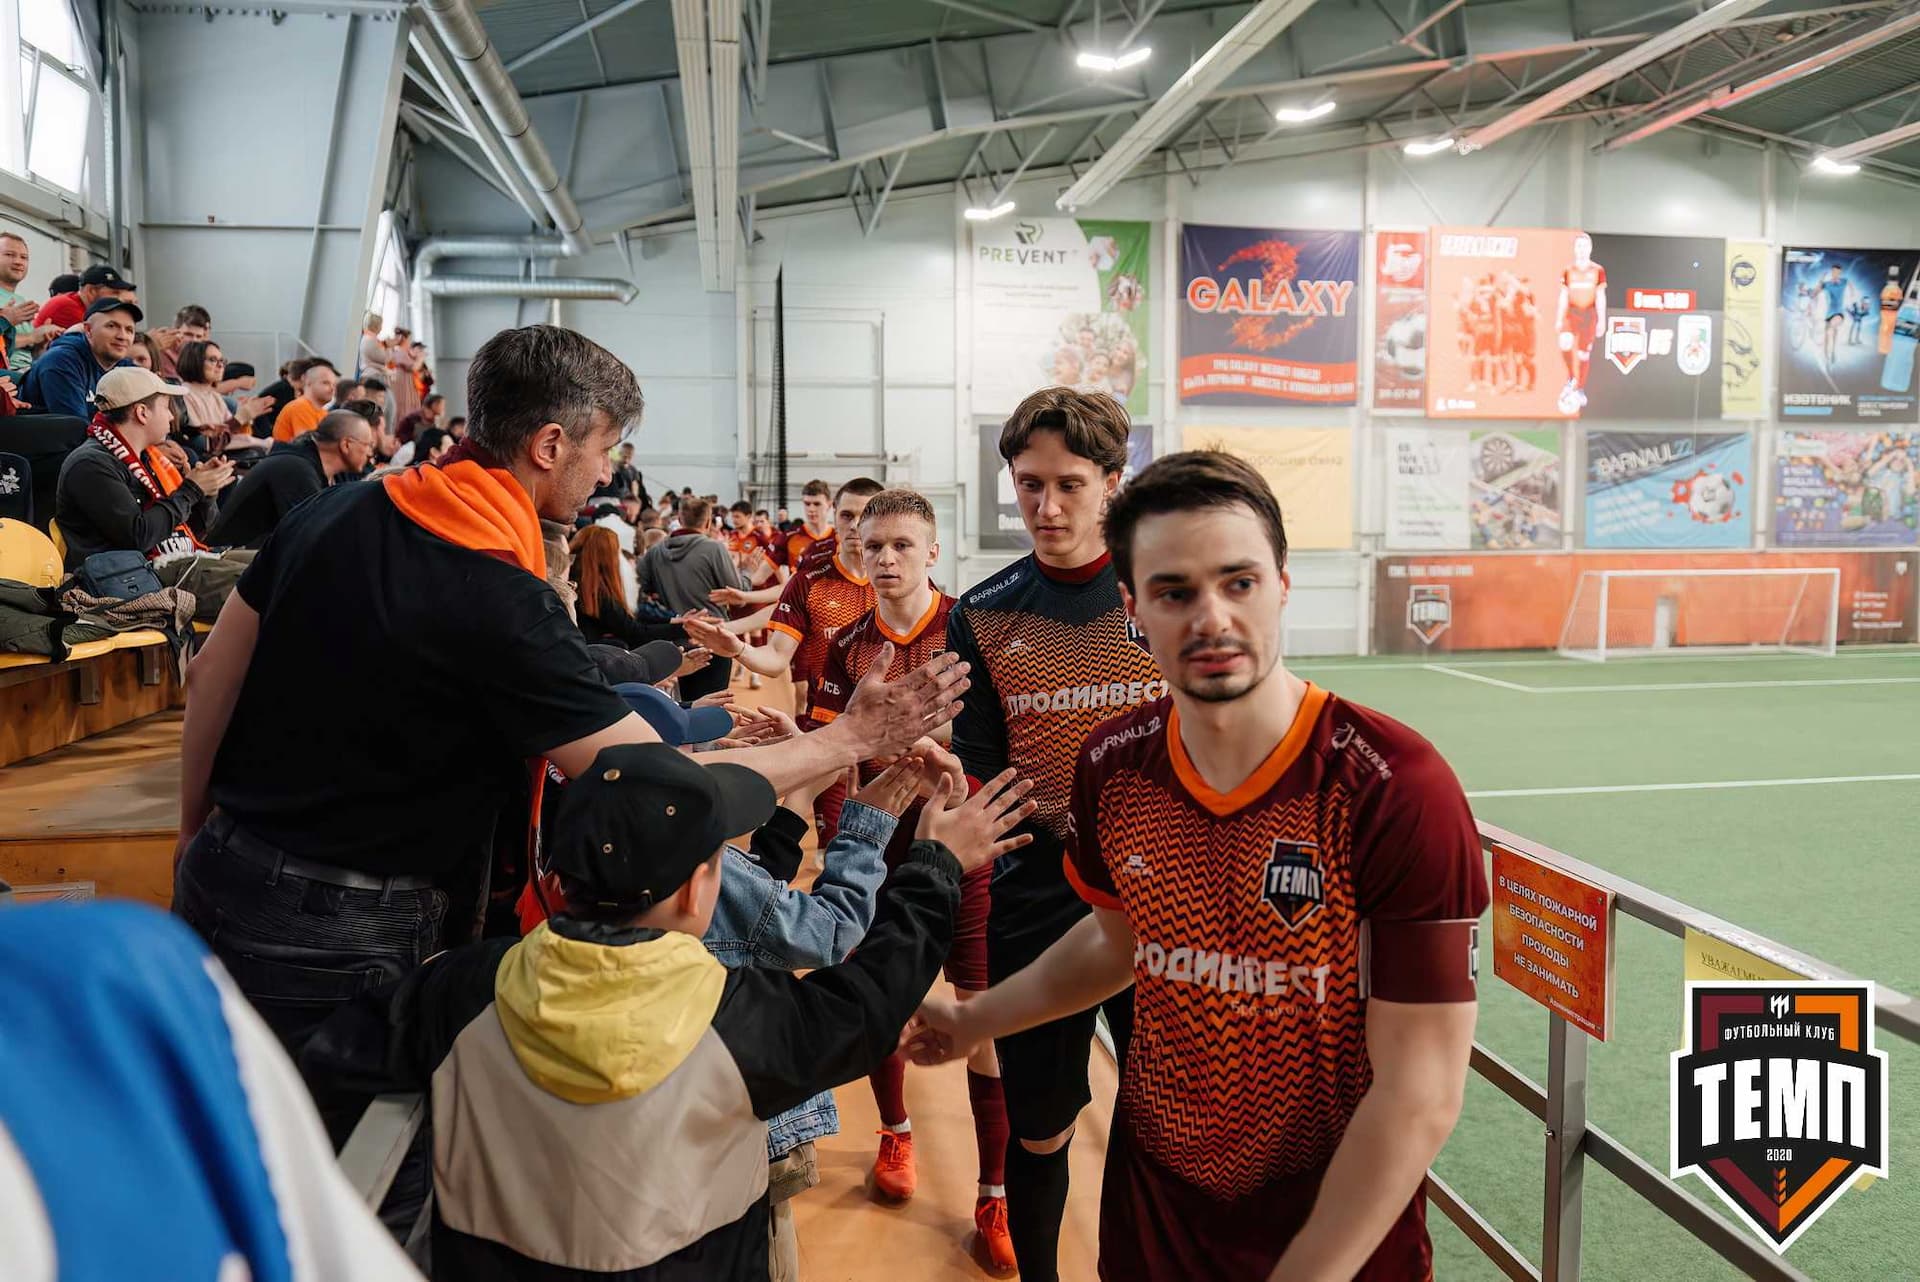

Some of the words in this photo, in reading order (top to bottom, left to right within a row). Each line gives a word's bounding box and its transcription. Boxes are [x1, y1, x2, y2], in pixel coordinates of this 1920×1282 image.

[979, 246, 1068, 265] PREVENT
[1187, 277, 1354, 317] GALAXY
[1269, 865, 1320, 900] ТЕМП
[1498, 875, 1508, 888] В
[1507, 878, 1537, 903] ЦЕЛЯХ
[1538, 895, 1598, 932] ПОЖАРНОЙ
[1509, 903, 1585, 951] БЕЗОПАСНОСТИ
[1134, 941, 1331, 1004] РОДИНВЕСТ
[1521, 934, 1570, 969] ПРОХОДЫ
[1513, 951, 1527, 969] НЕ
[1527, 959, 1580, 999] ЗАНИМАТЬ
